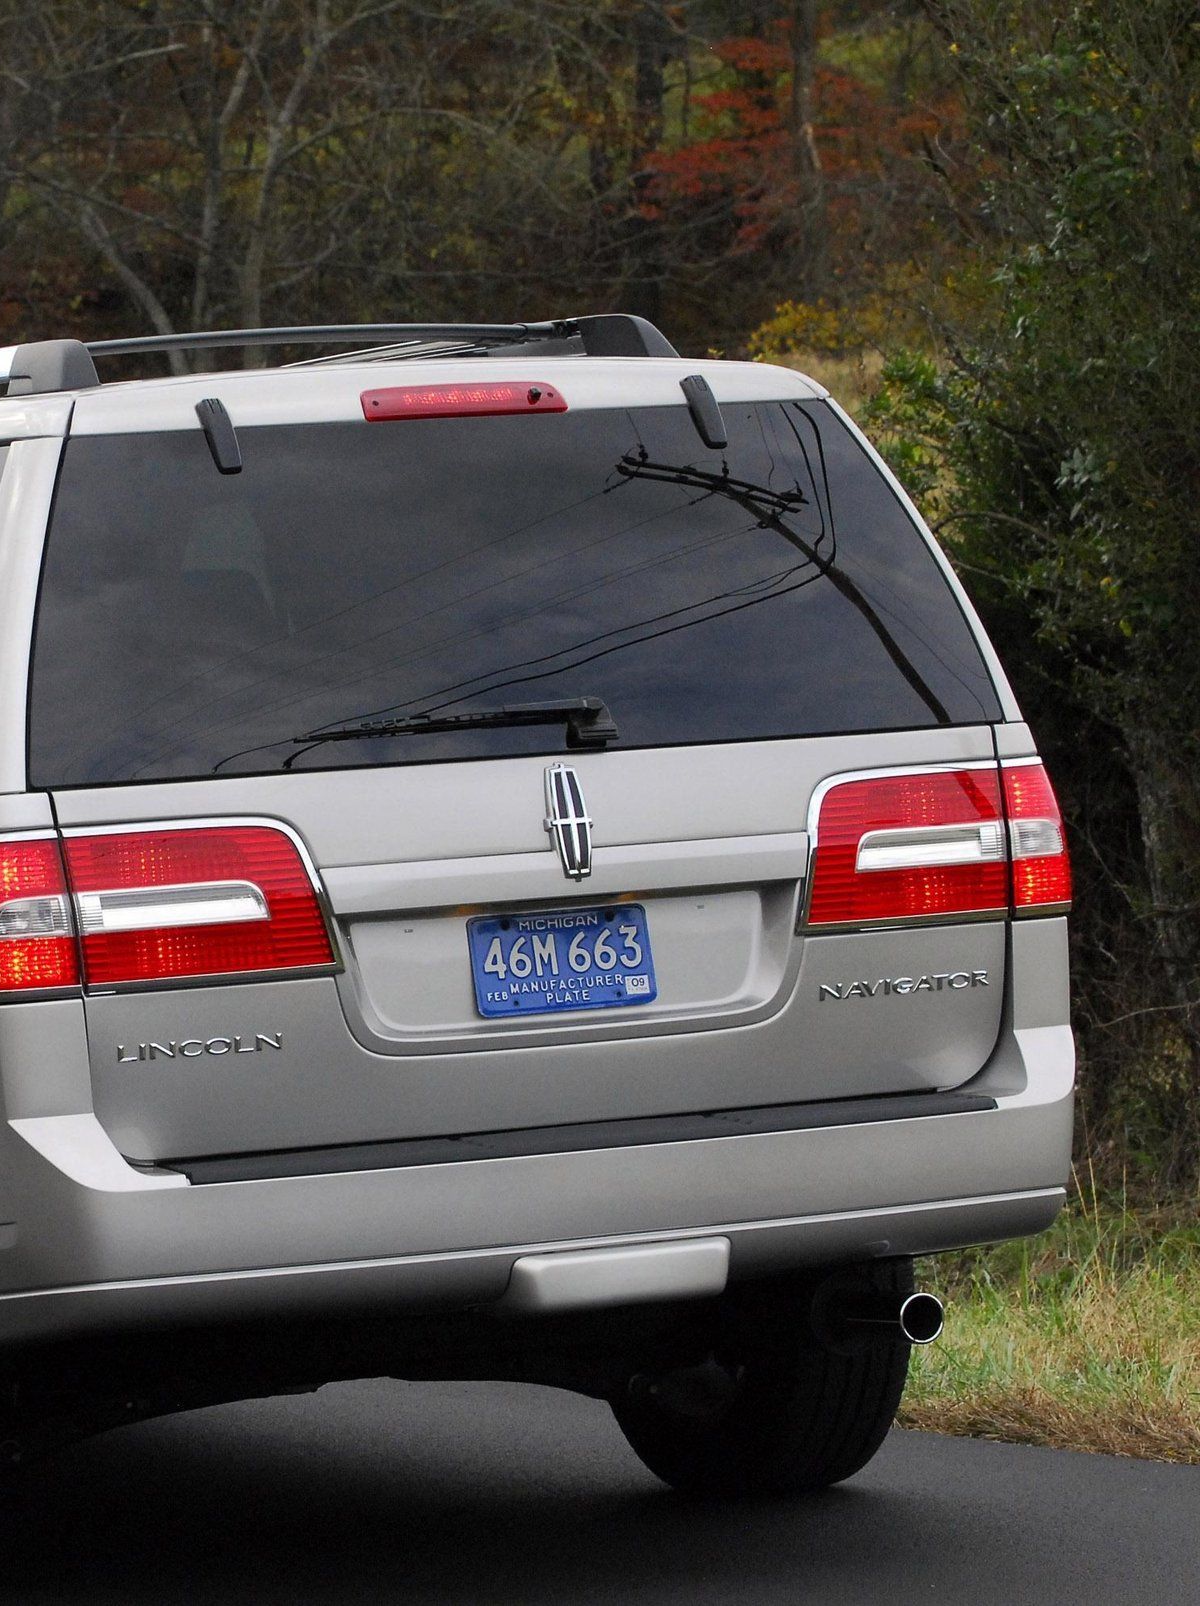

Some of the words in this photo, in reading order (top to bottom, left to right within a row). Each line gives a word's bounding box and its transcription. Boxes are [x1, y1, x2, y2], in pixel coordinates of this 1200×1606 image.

[518, 915, 599, 931] MICHIGAN
[484, 932, 560, 980] 46M
[568, 925, 643, 974] 663
[510, 973, 624, 995] MANUFACTURER
[631, 978, 645, 987] 09
[819, 970, 990, 1002] NAVIGATOR
[487, 990, 509, 1002] FEB
[547, 989, 592, 1004] PLATE
[116, 1032, 283, 1063] LINCOLN
